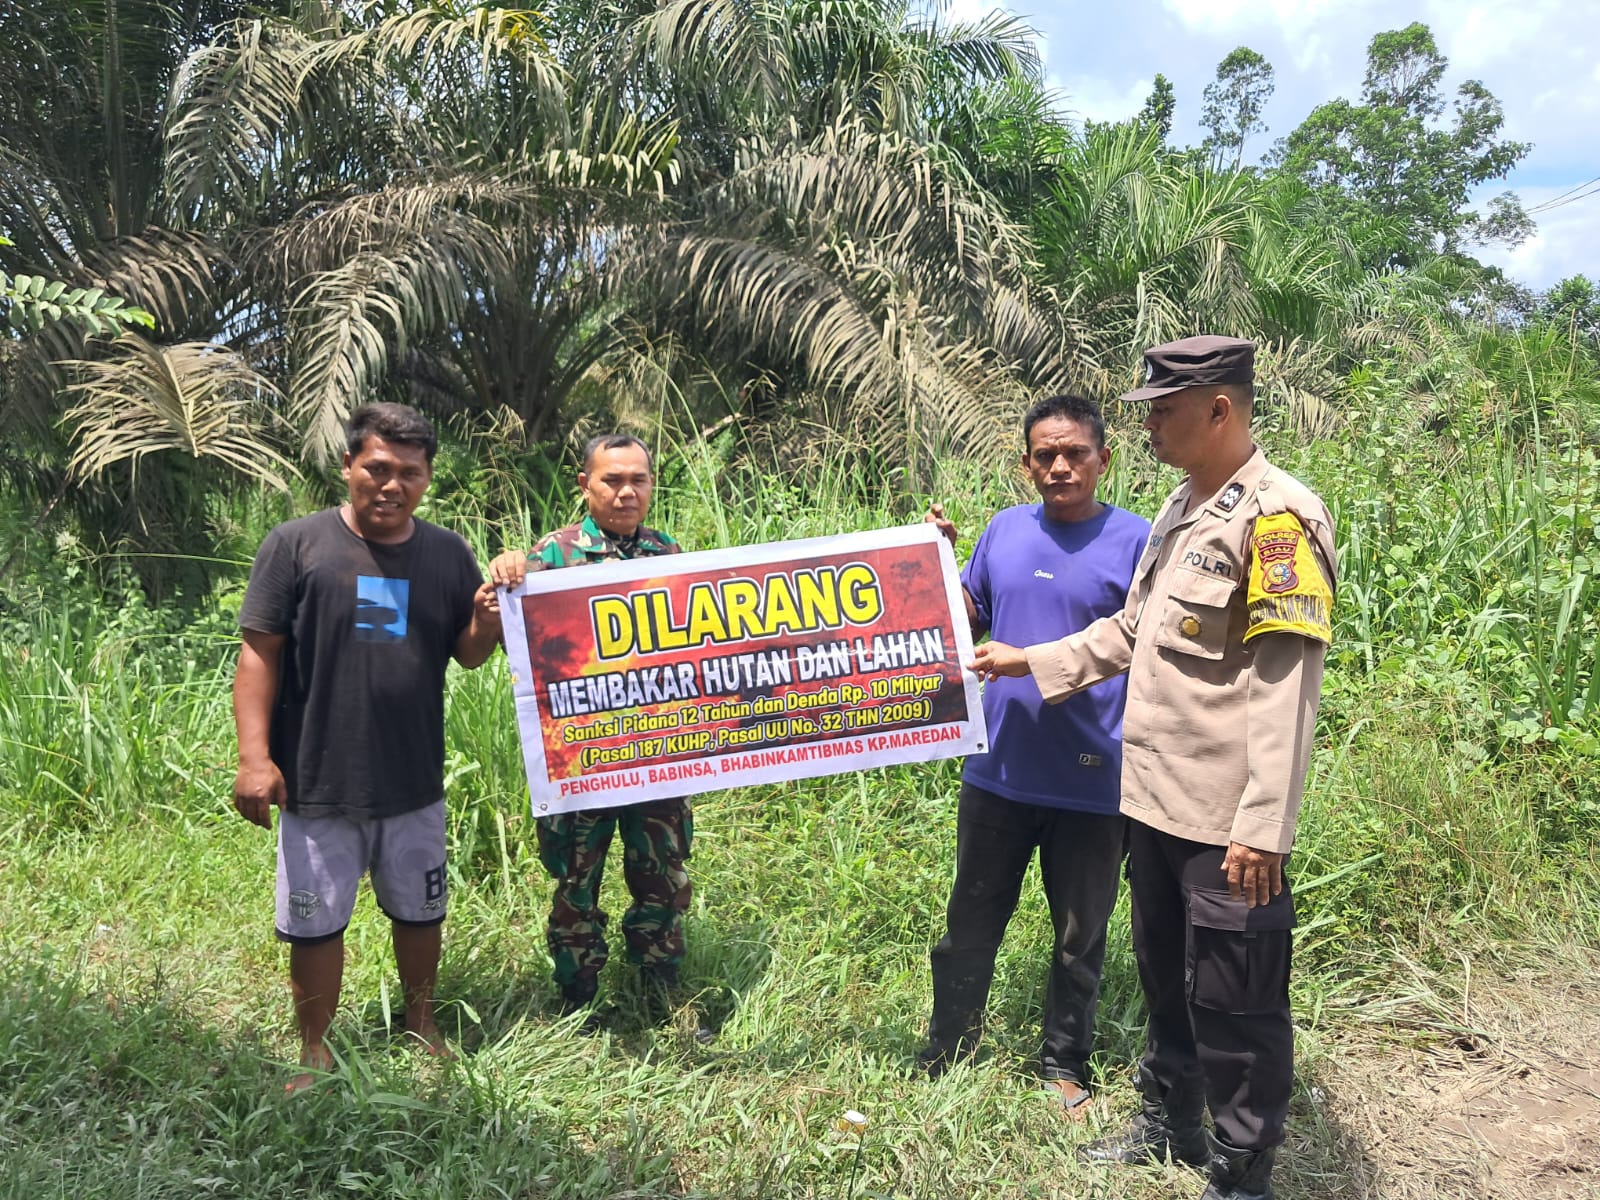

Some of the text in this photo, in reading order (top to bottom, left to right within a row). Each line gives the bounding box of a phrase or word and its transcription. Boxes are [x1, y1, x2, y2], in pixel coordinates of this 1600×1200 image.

[1184, 551, 1233, 577] POLRI
[1257, 532, 1297, 543] POLRES
[1263, 547, 1291, 555] RIAU
[591, 564, 882, 660] DILARANG
[549, 628, 945, 718] MEMBAKAR HUTAN DAN LAHAN
[564, 674, 942, 743] Sanksi Pidana 12 Tahun dan Denda Rp. 10 Milyar
[581, 700, 932, 768] (Pasal 187 KUHP, Pasal UU No. 32 THN 2009)
[560, 725, 961, 797] PENGHULU, BABINSA, BHABINKAMTIBMAS KP.MAREDAN
